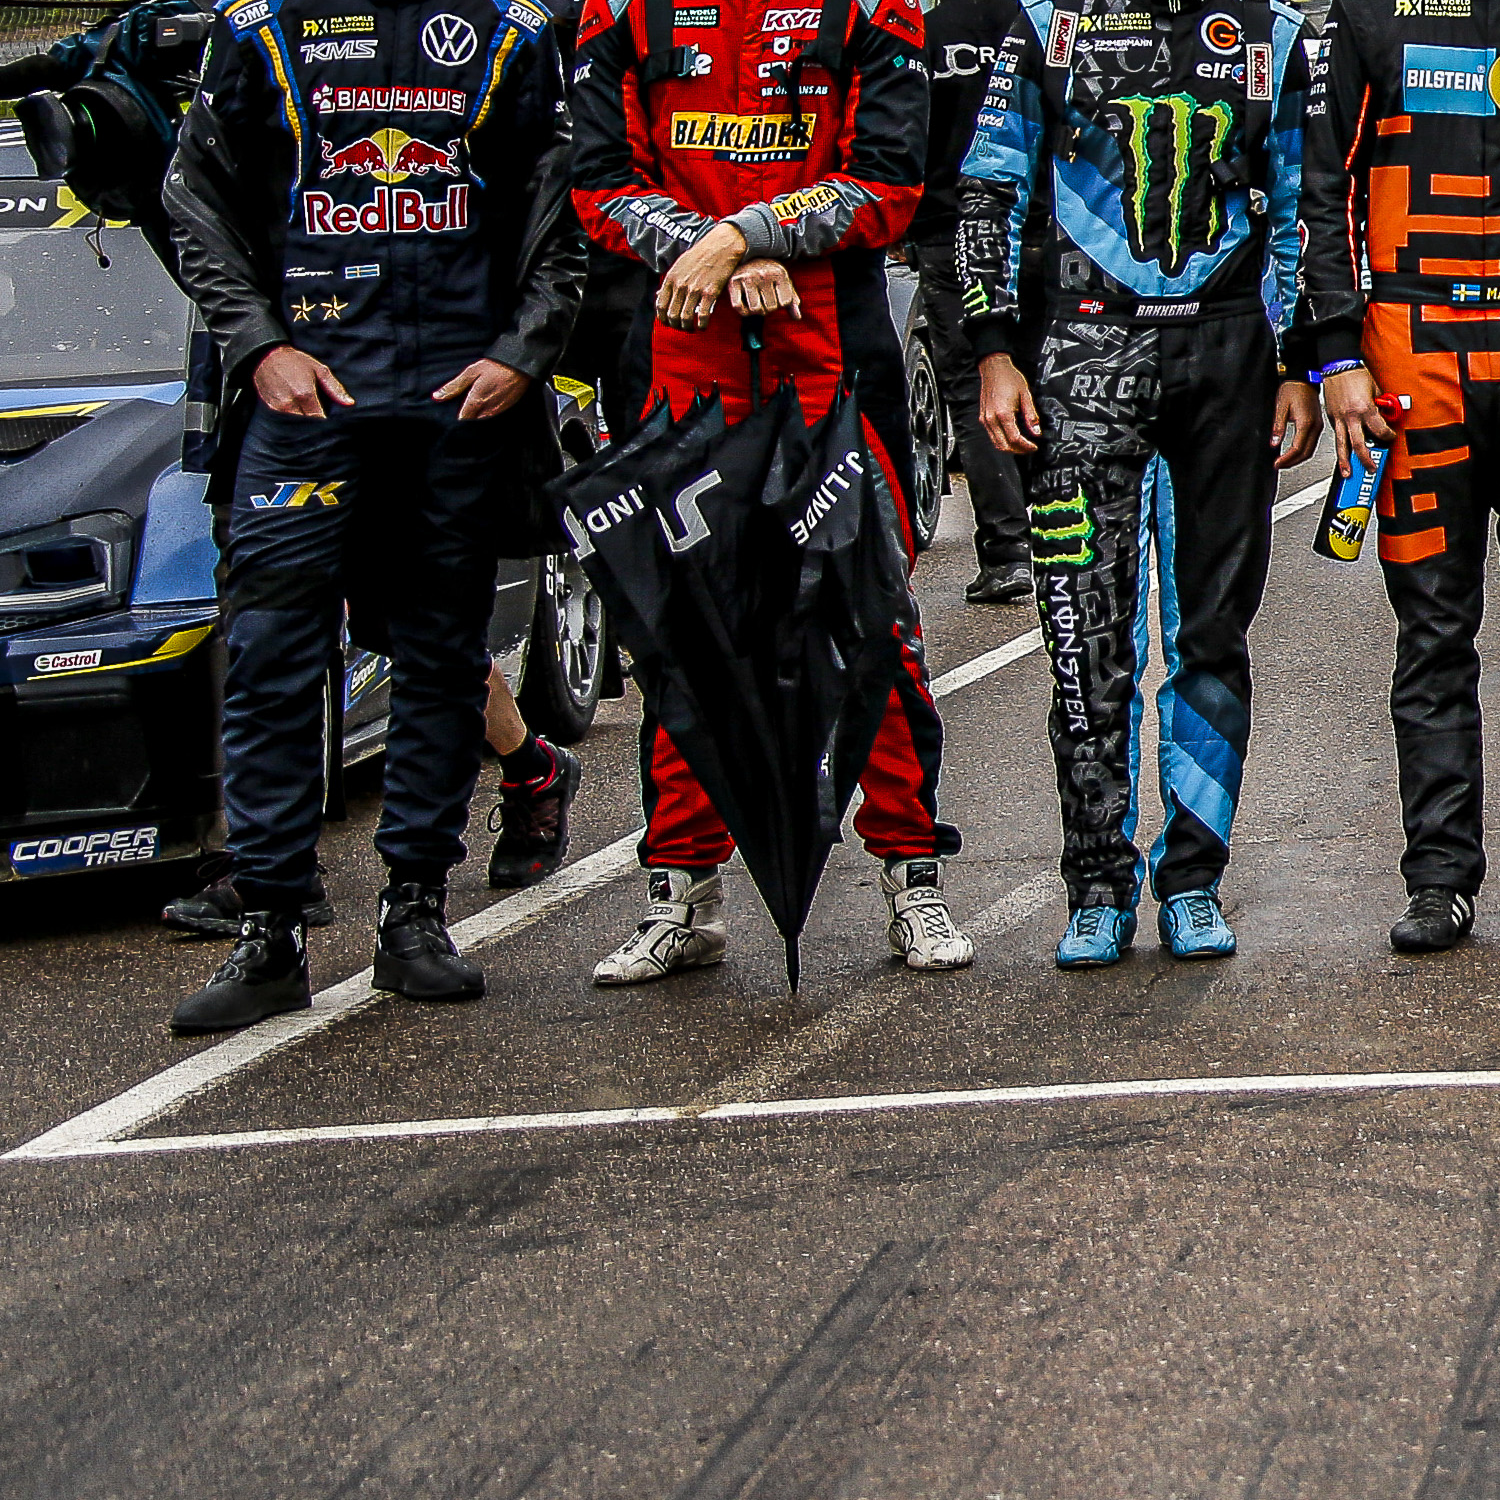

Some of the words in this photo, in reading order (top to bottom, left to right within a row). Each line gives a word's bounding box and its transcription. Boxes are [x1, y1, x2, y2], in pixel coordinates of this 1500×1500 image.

[233, 2, 271, 27] OMP
[508, 5, 543, 31] OMP
[1053, 17, 1072, 62] SIMPSON
[1094, 38, 1153, 47] ZIMMERMANN
[1196, 62, 1231, 80] elf
[1254, 50, 1266, 95] SIMPSON
[1405, 67, 1485, 92] BILSTEIN
[338, 90, 464, 112] BAUHAUS
[304, 186, 389, 235] Red
[392, 184, 469, 233] Bull
[1070, 374, 1113, 398] RX
[51, 652, 97, 670] Castrol
[13, 827, 158, 862] COOPER
[84, 847, 154, 867] TIRES
